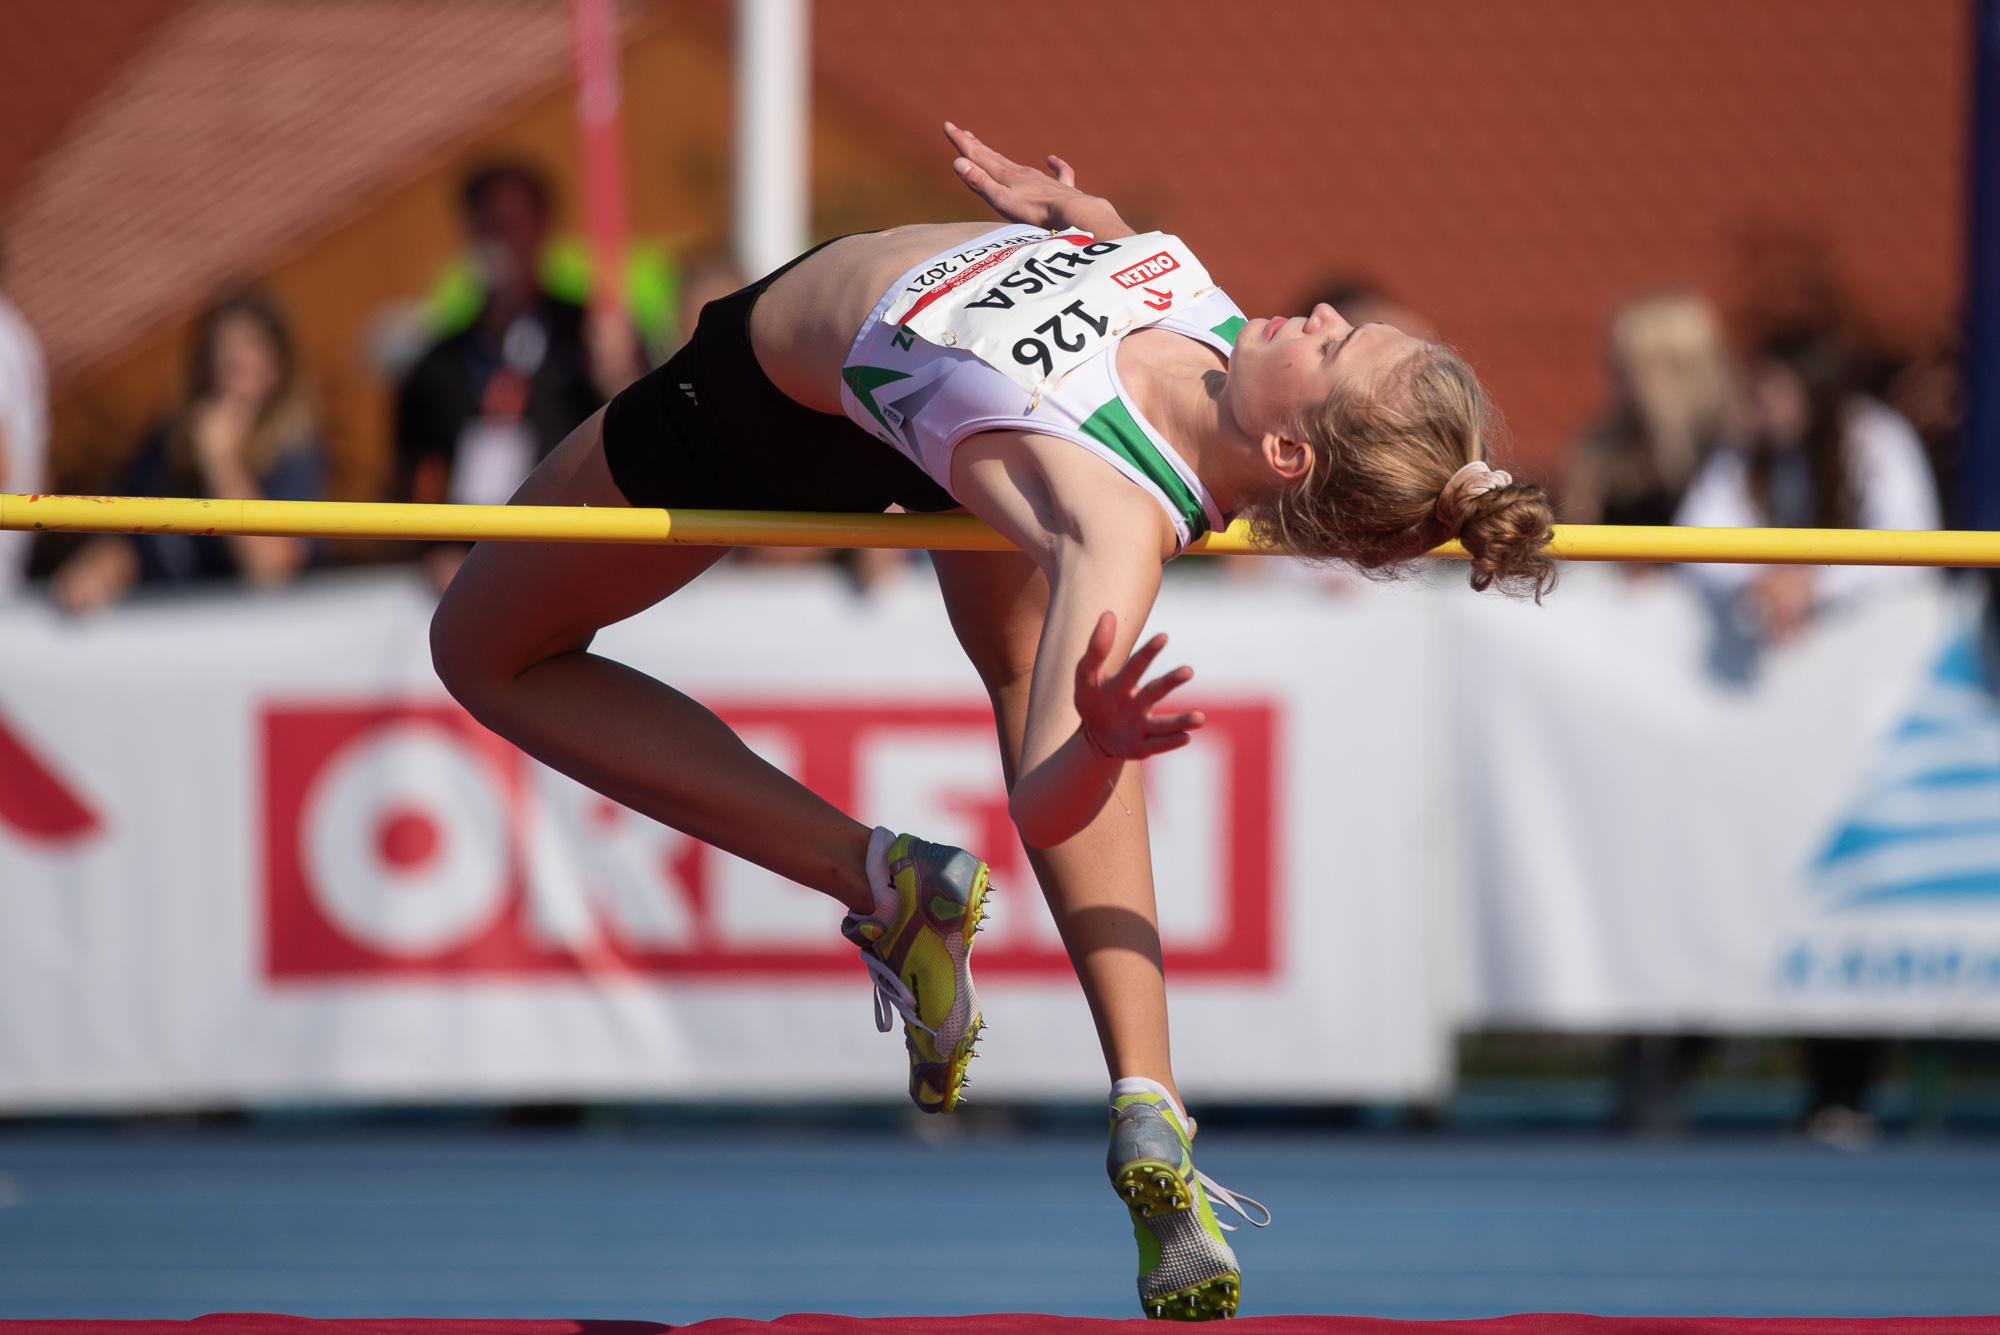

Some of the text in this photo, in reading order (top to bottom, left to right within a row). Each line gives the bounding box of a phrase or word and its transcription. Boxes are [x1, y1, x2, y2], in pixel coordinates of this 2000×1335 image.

[906, 261, 958, 293] 2021
[1115, 255, 1174, 287] ORLEN
[1011, 299, 1109, 378] 126
